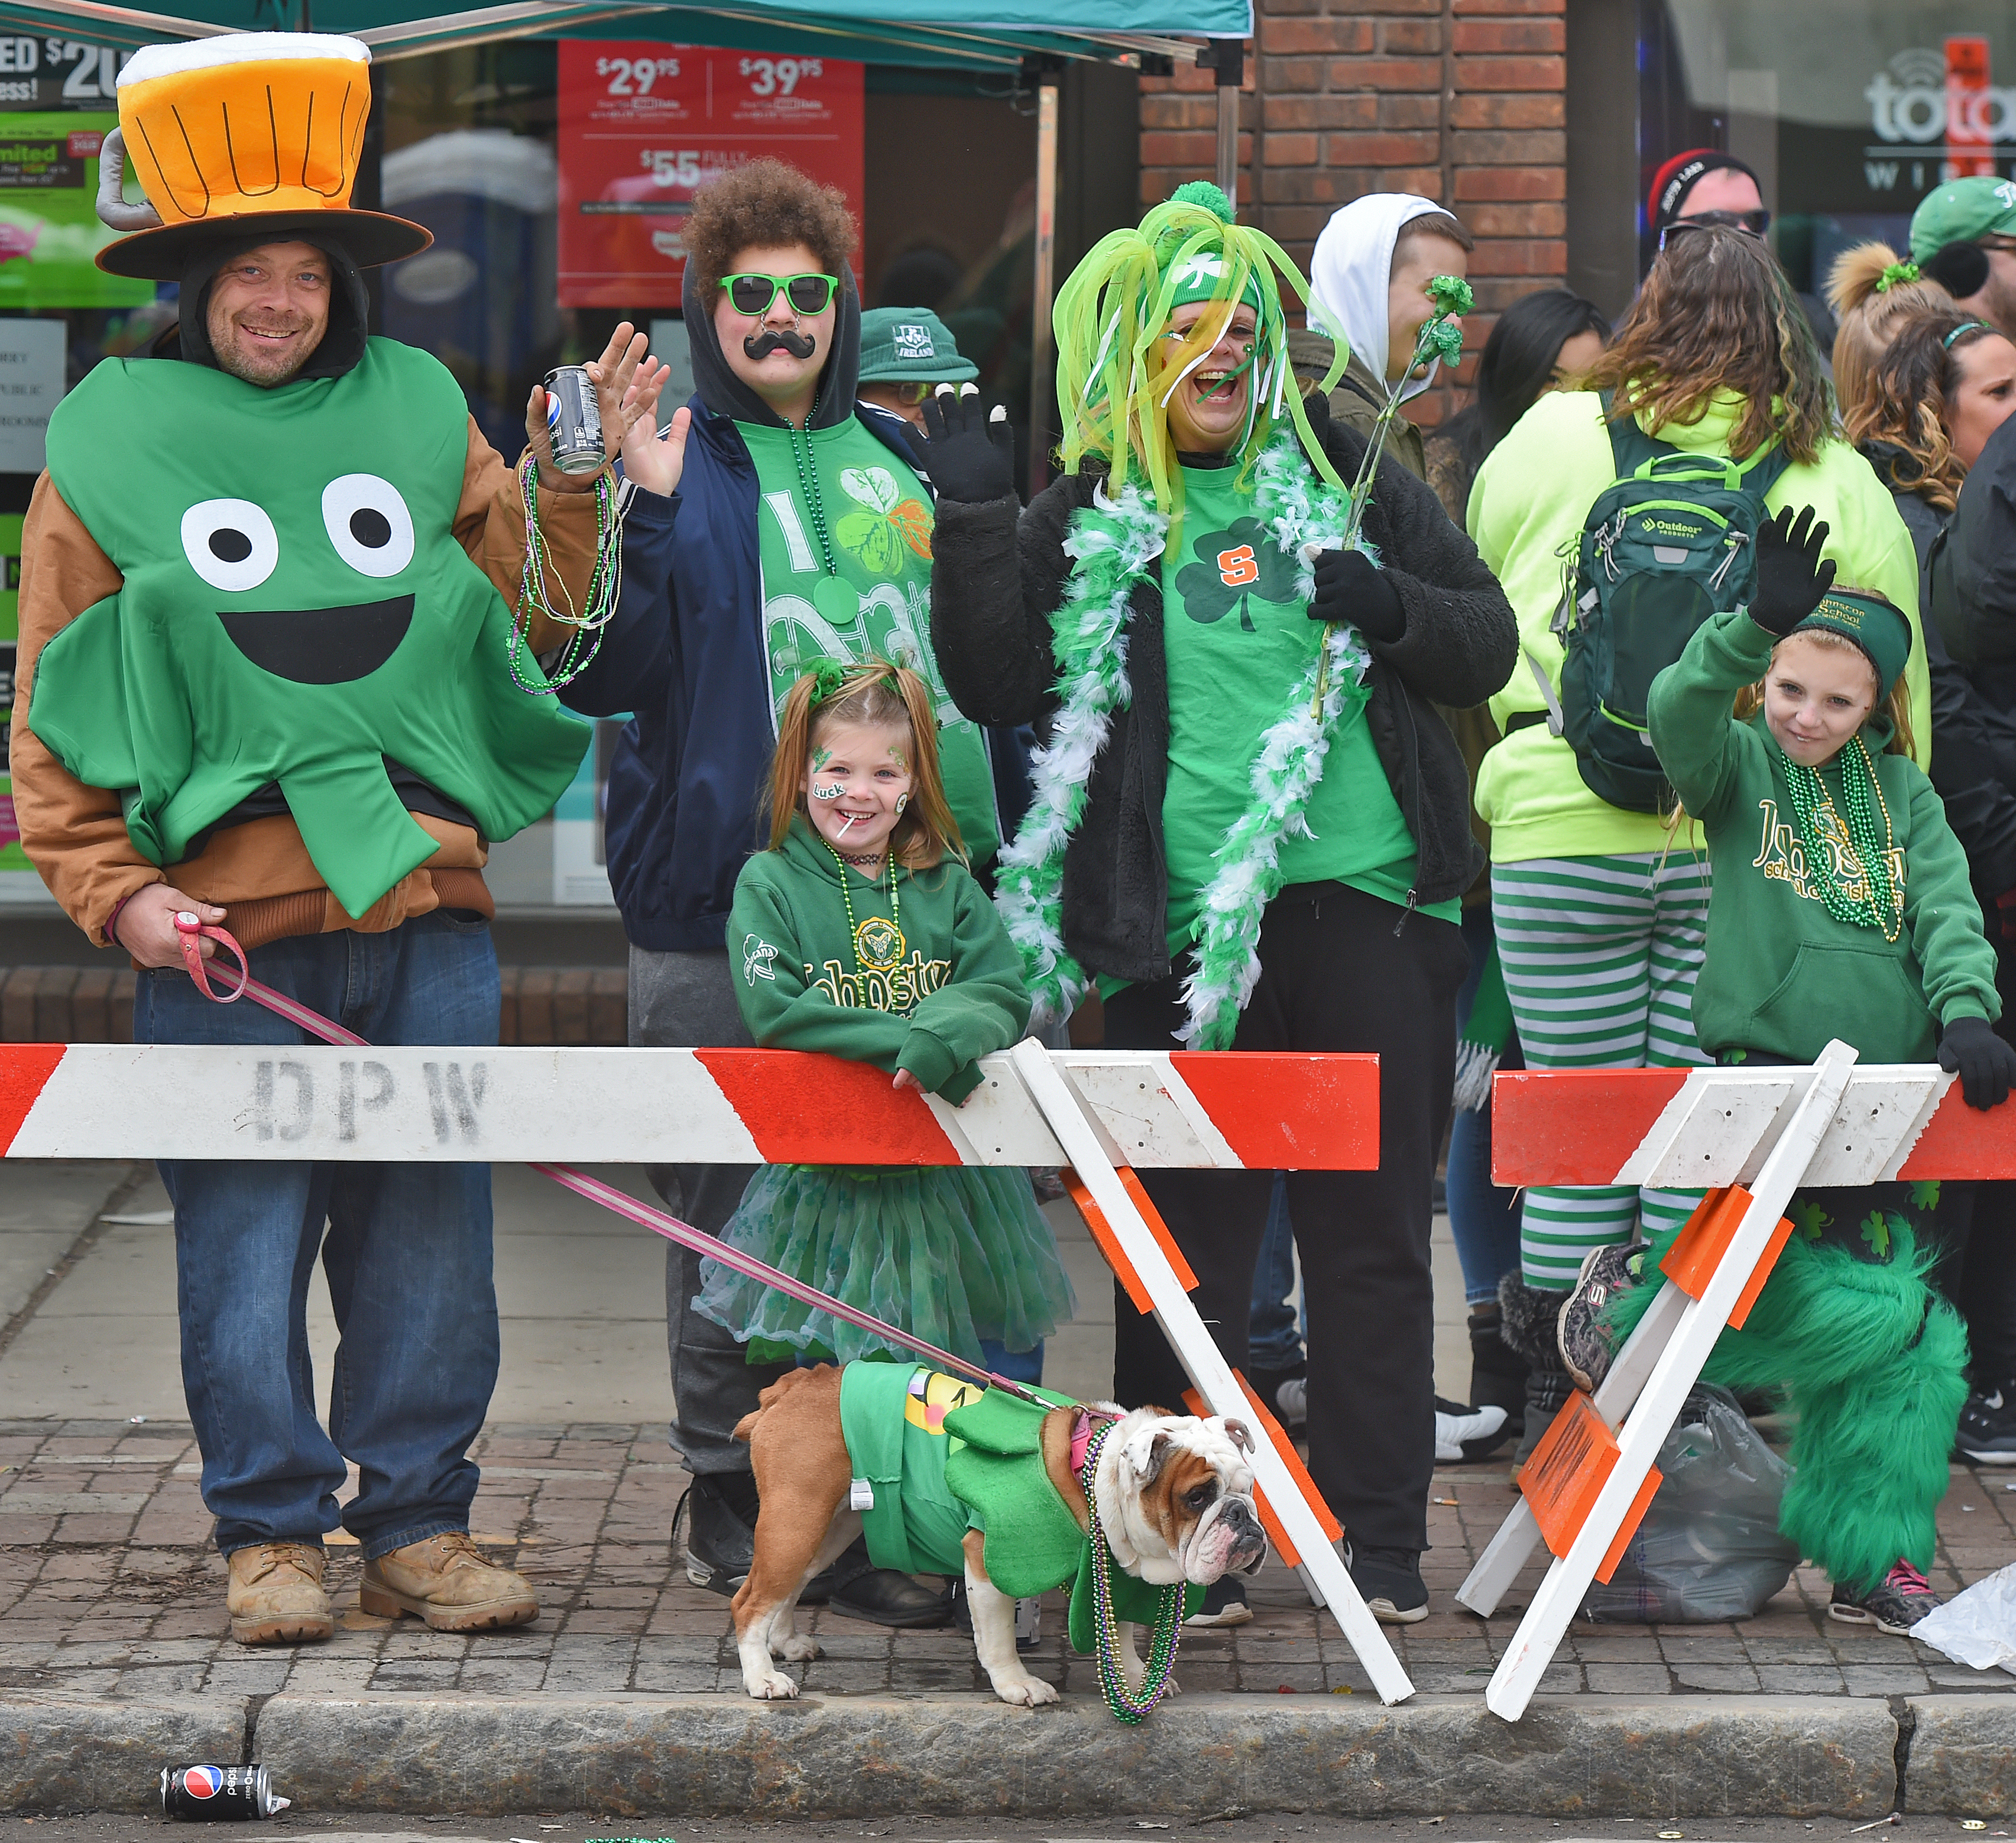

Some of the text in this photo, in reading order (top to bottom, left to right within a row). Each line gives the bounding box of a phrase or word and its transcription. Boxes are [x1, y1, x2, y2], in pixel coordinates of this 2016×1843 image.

[641, 150, 701, 187] $55
[899, 346, 934, 358] IRELAND
[1657, 520, 1699, 534] Outdoor
[1659, 529, 1695, 539] PRODUCTS
[1216, 543, 1259, 587] S
[813, 783, 846, 799] Luck
[255, 1061, 489, 1143] DPW
[227, 1767, 238, 1796] pepsi
